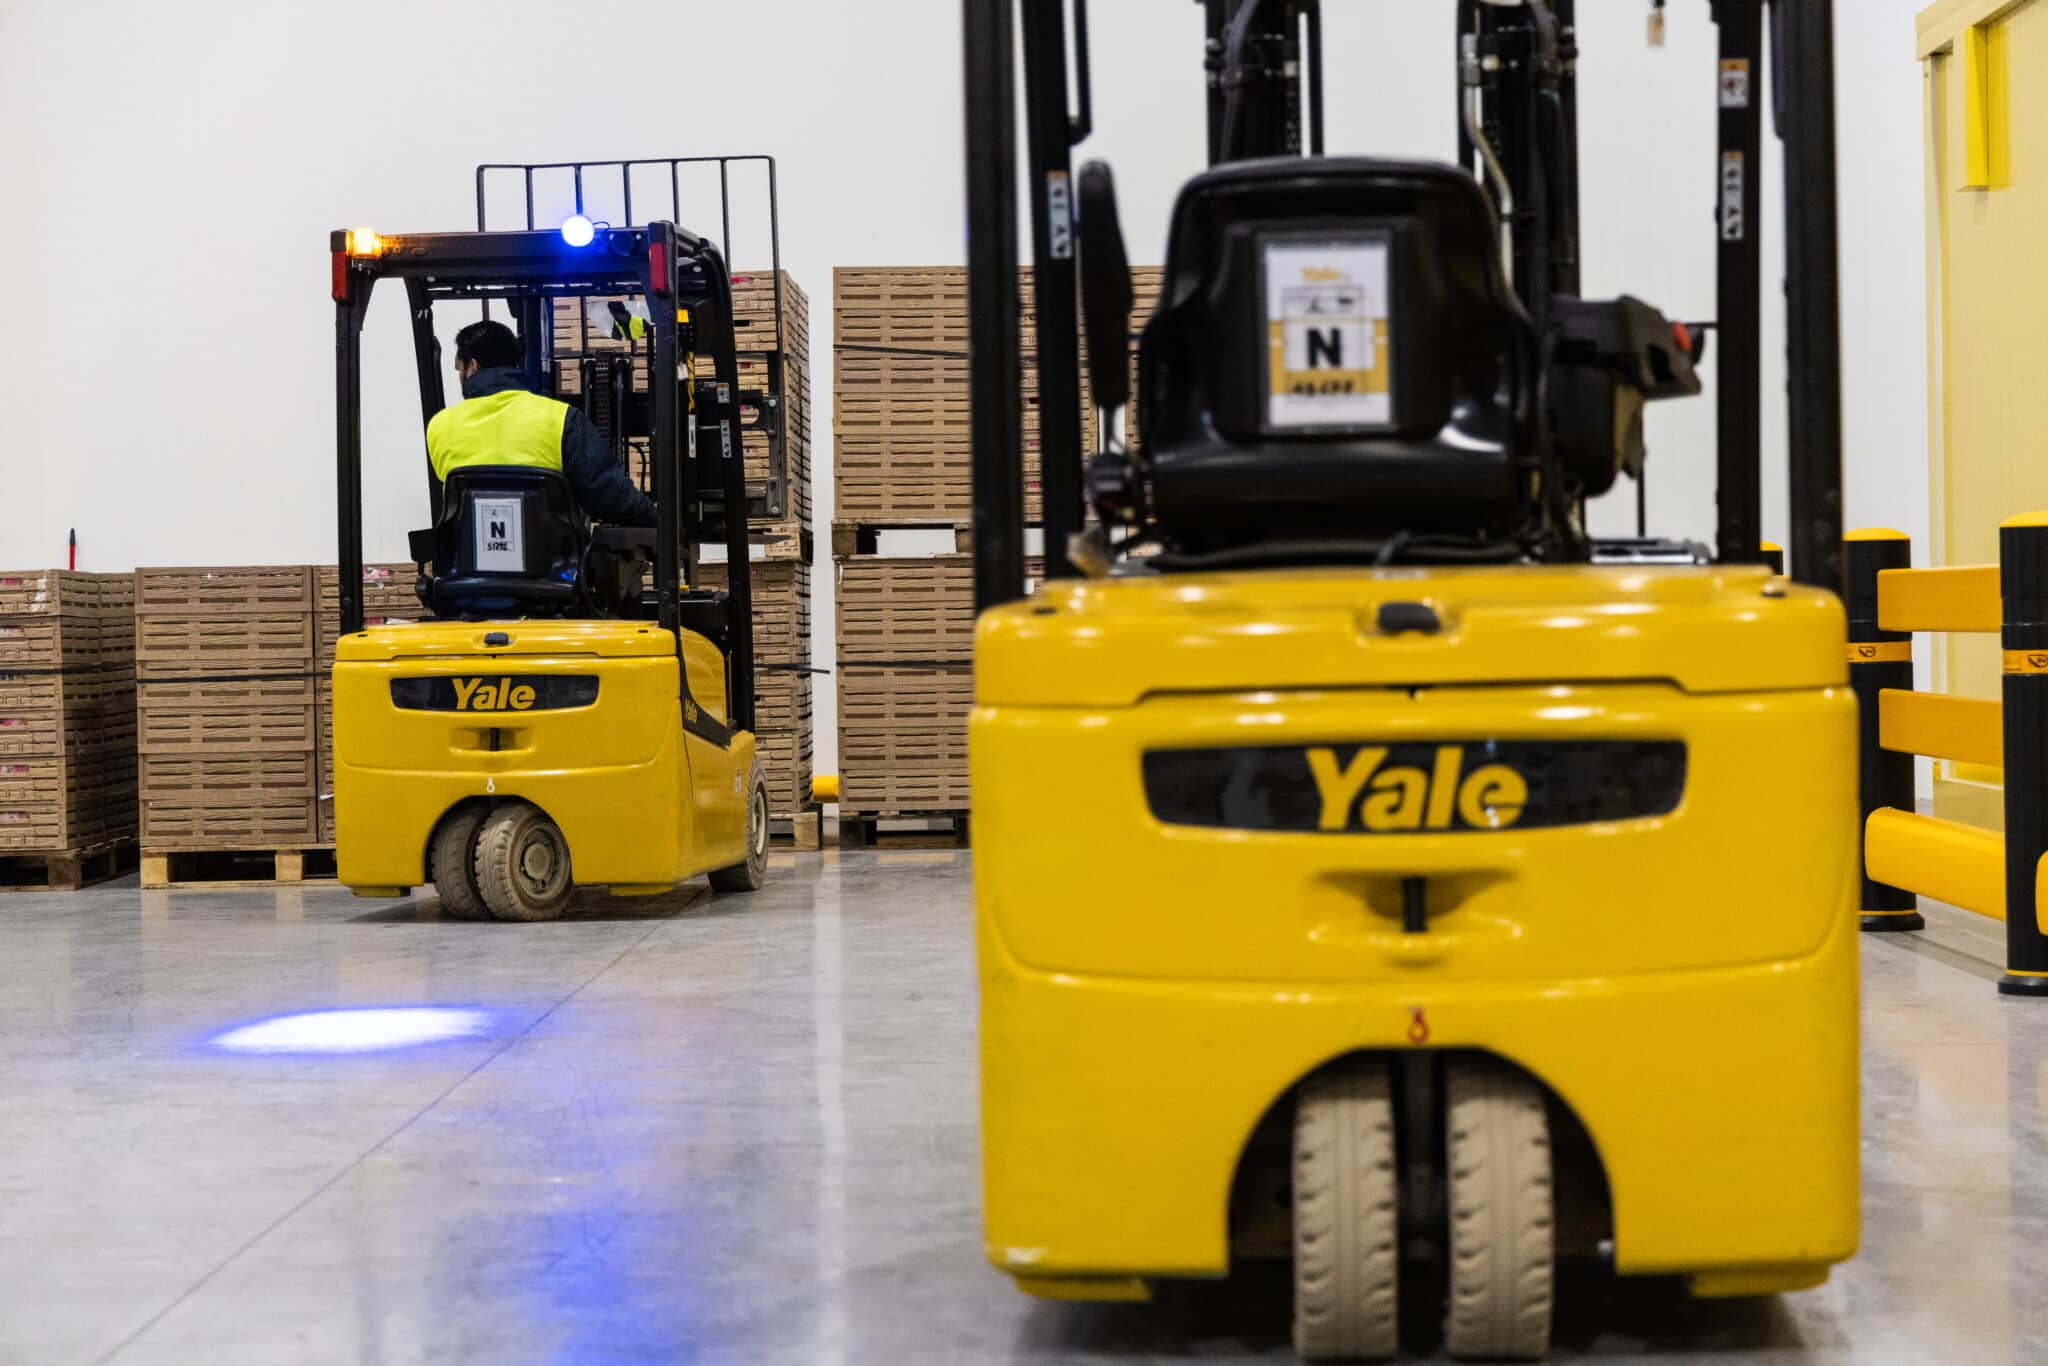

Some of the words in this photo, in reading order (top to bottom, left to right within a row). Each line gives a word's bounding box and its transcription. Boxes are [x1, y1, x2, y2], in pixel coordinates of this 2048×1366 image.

[1306, 327, 1342, 369] N
[490, 522, 506, 539] N
[452, 677, 536, 710] Yale
[1304, 746, 1528, 832] Yale
